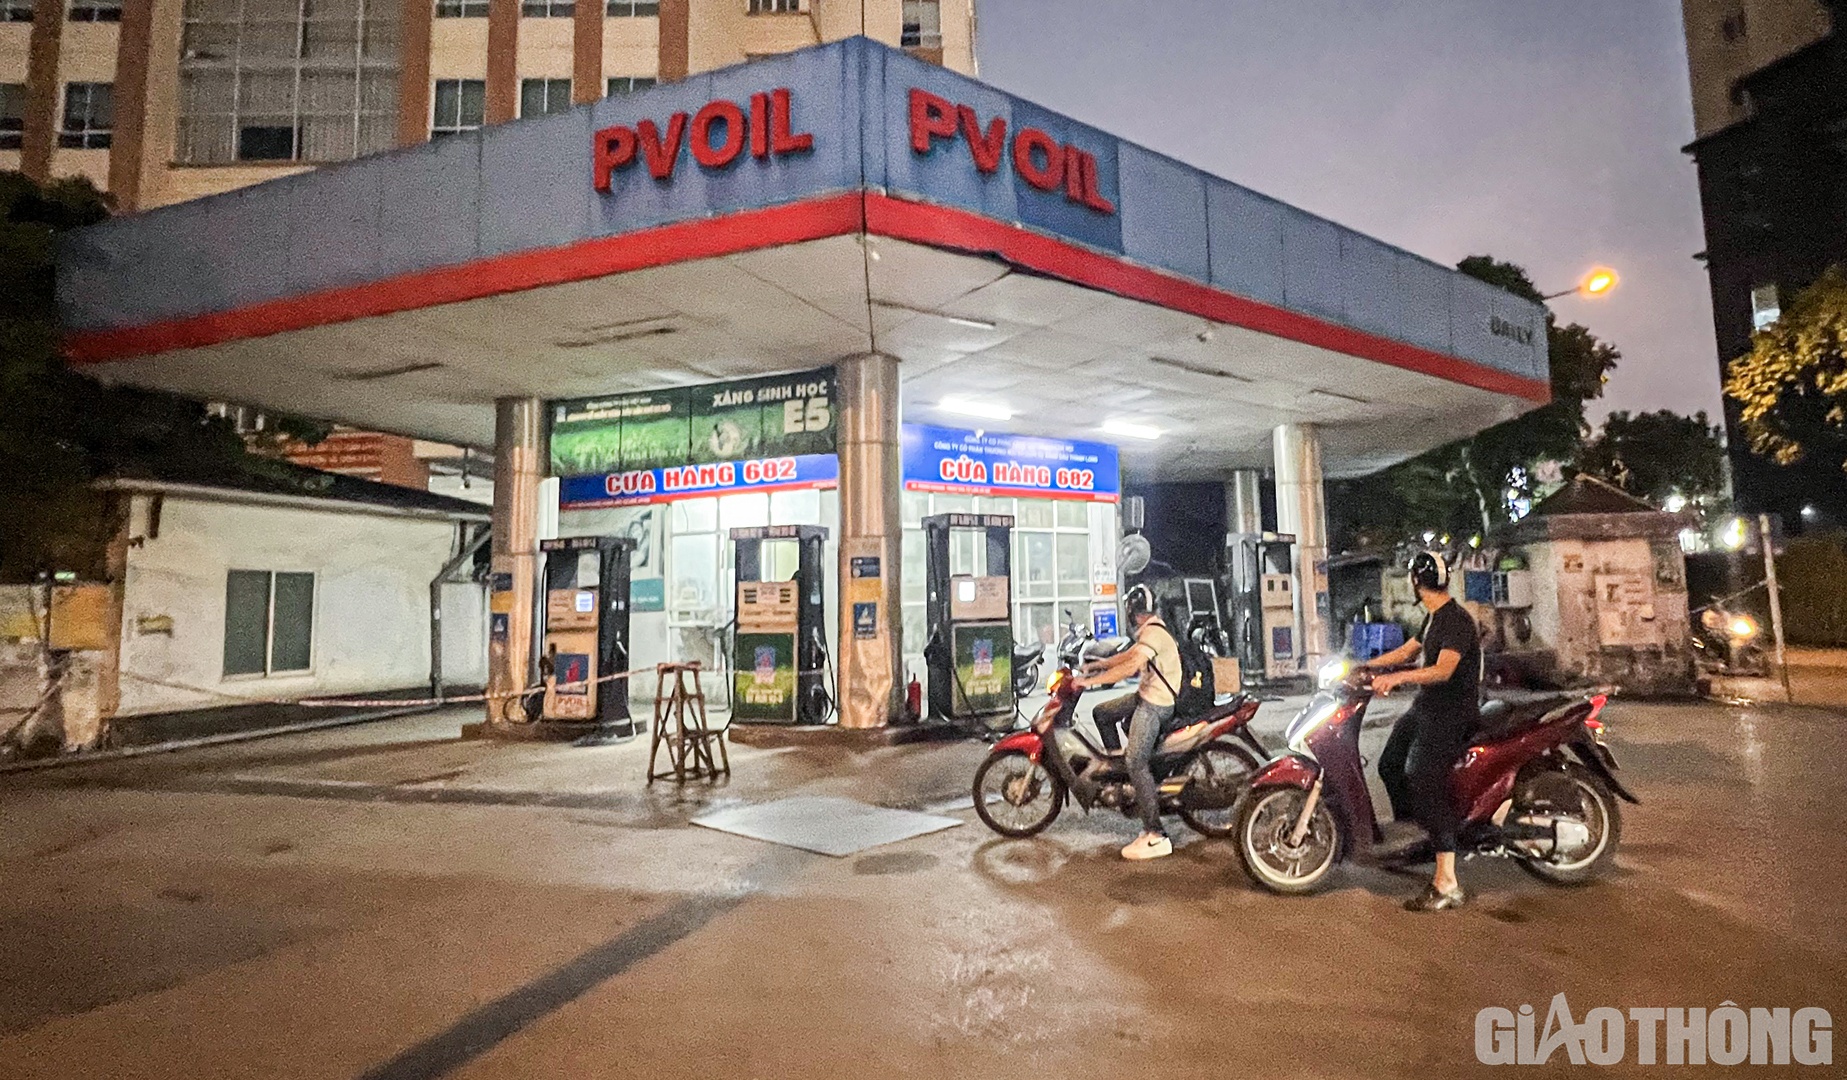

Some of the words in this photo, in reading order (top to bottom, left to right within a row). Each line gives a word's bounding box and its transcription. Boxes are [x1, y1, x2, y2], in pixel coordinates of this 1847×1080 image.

[593, 88, 813, 193] PVOIL
[909, 88, 1115, 215] PVOIL
[784, 397, 830, 433] E5
[940, 454, 987, 483] CỬA
[993, 461, 1050, 488] HÀNG
